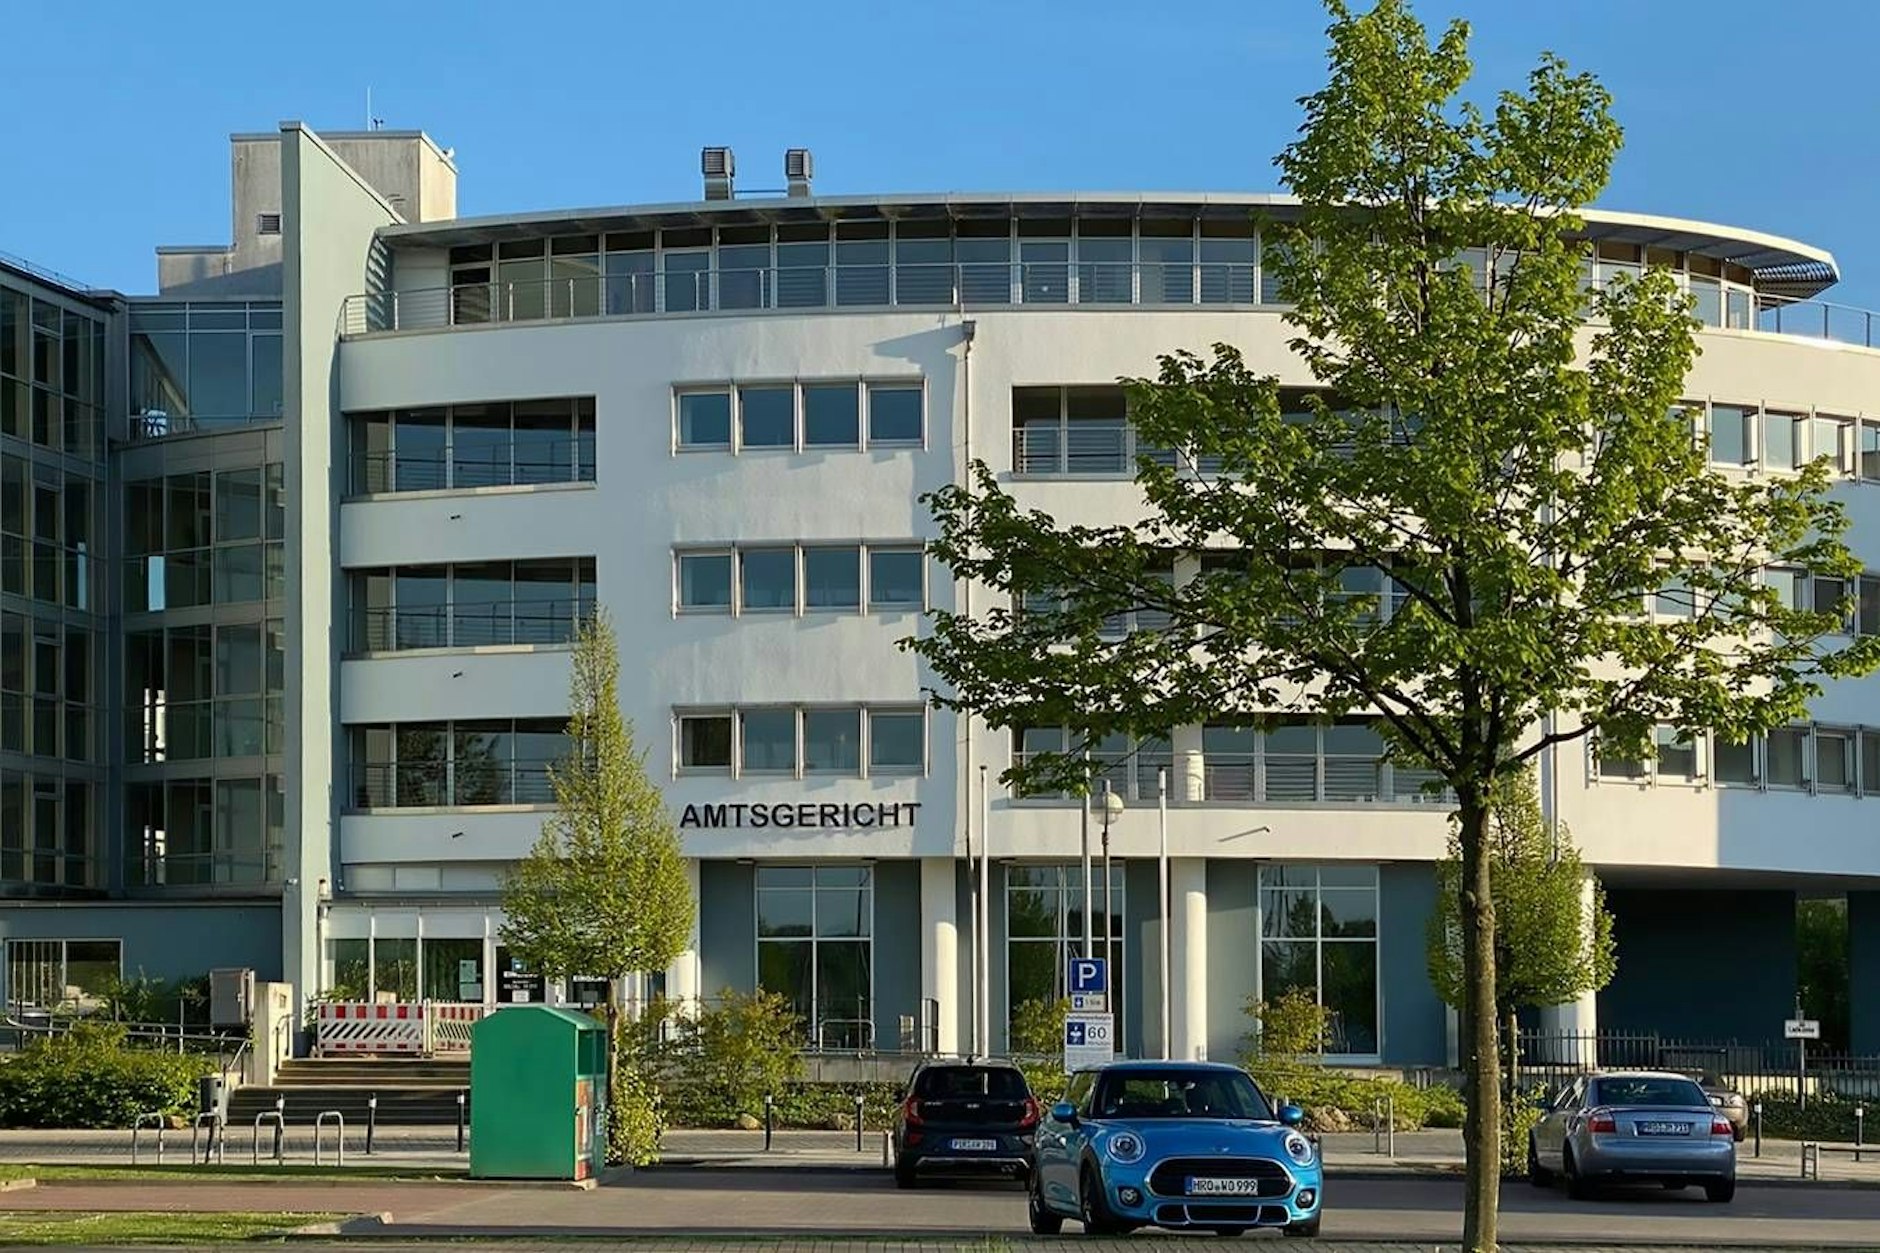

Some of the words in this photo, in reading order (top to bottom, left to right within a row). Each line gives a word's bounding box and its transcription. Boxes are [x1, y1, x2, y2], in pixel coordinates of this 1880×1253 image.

[680, 803, 922, 828] AMTSGERICHT
[1078, 962, 1097, 988] P
[1088, 1026, 1107, 1039] 60
